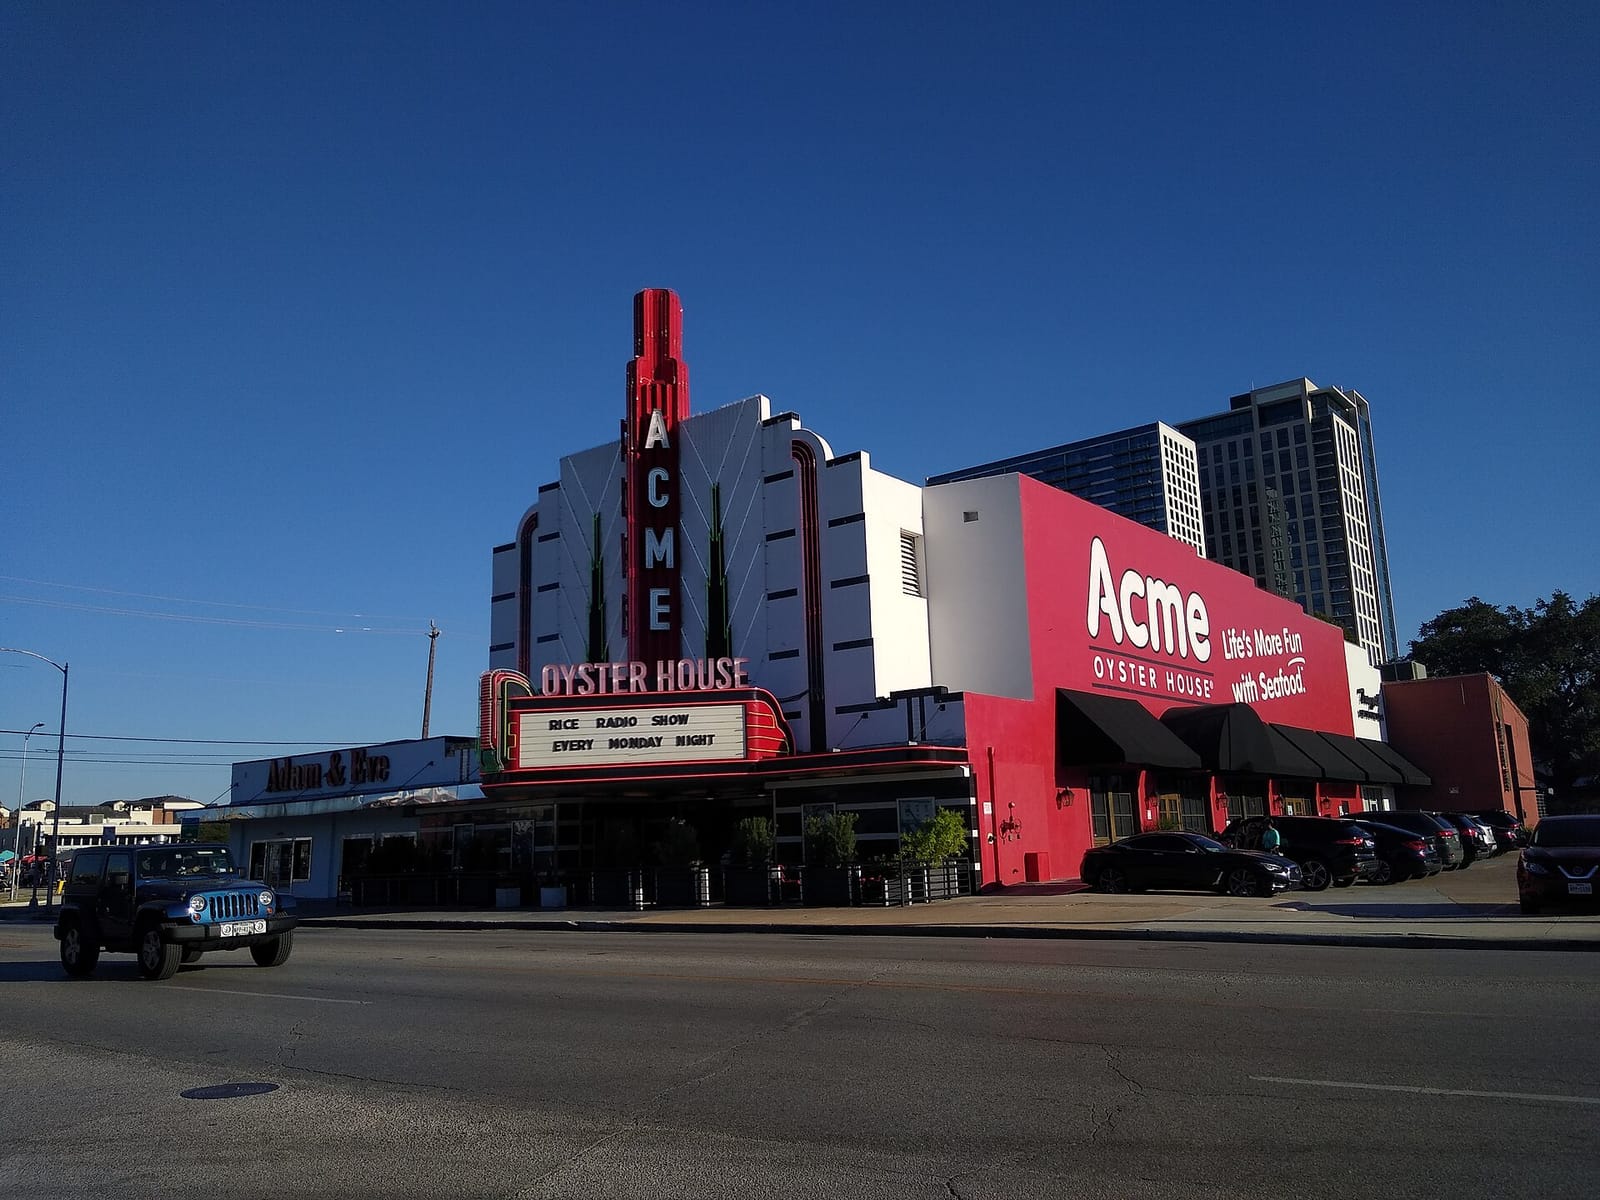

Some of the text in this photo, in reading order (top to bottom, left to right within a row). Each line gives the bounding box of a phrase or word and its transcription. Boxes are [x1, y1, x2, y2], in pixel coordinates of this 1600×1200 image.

[644, 408, 674, 631] ACME
[1087, 536, 1212, 664] Acme
[1221, 627, 1303, 660] Life's More Fun
[541, 656, 750, 697] OYSTER HOUSE
[1093, 656, 1157, 689] OYSTER
[1231, 671, 1259, 704] with
[548, 713, 690, 731] RICE RADIO SHOW
[552, 734, 715, 752] EVERY MONDAY NIGHT
[266, 749, 390, 792] Adam & Eve
